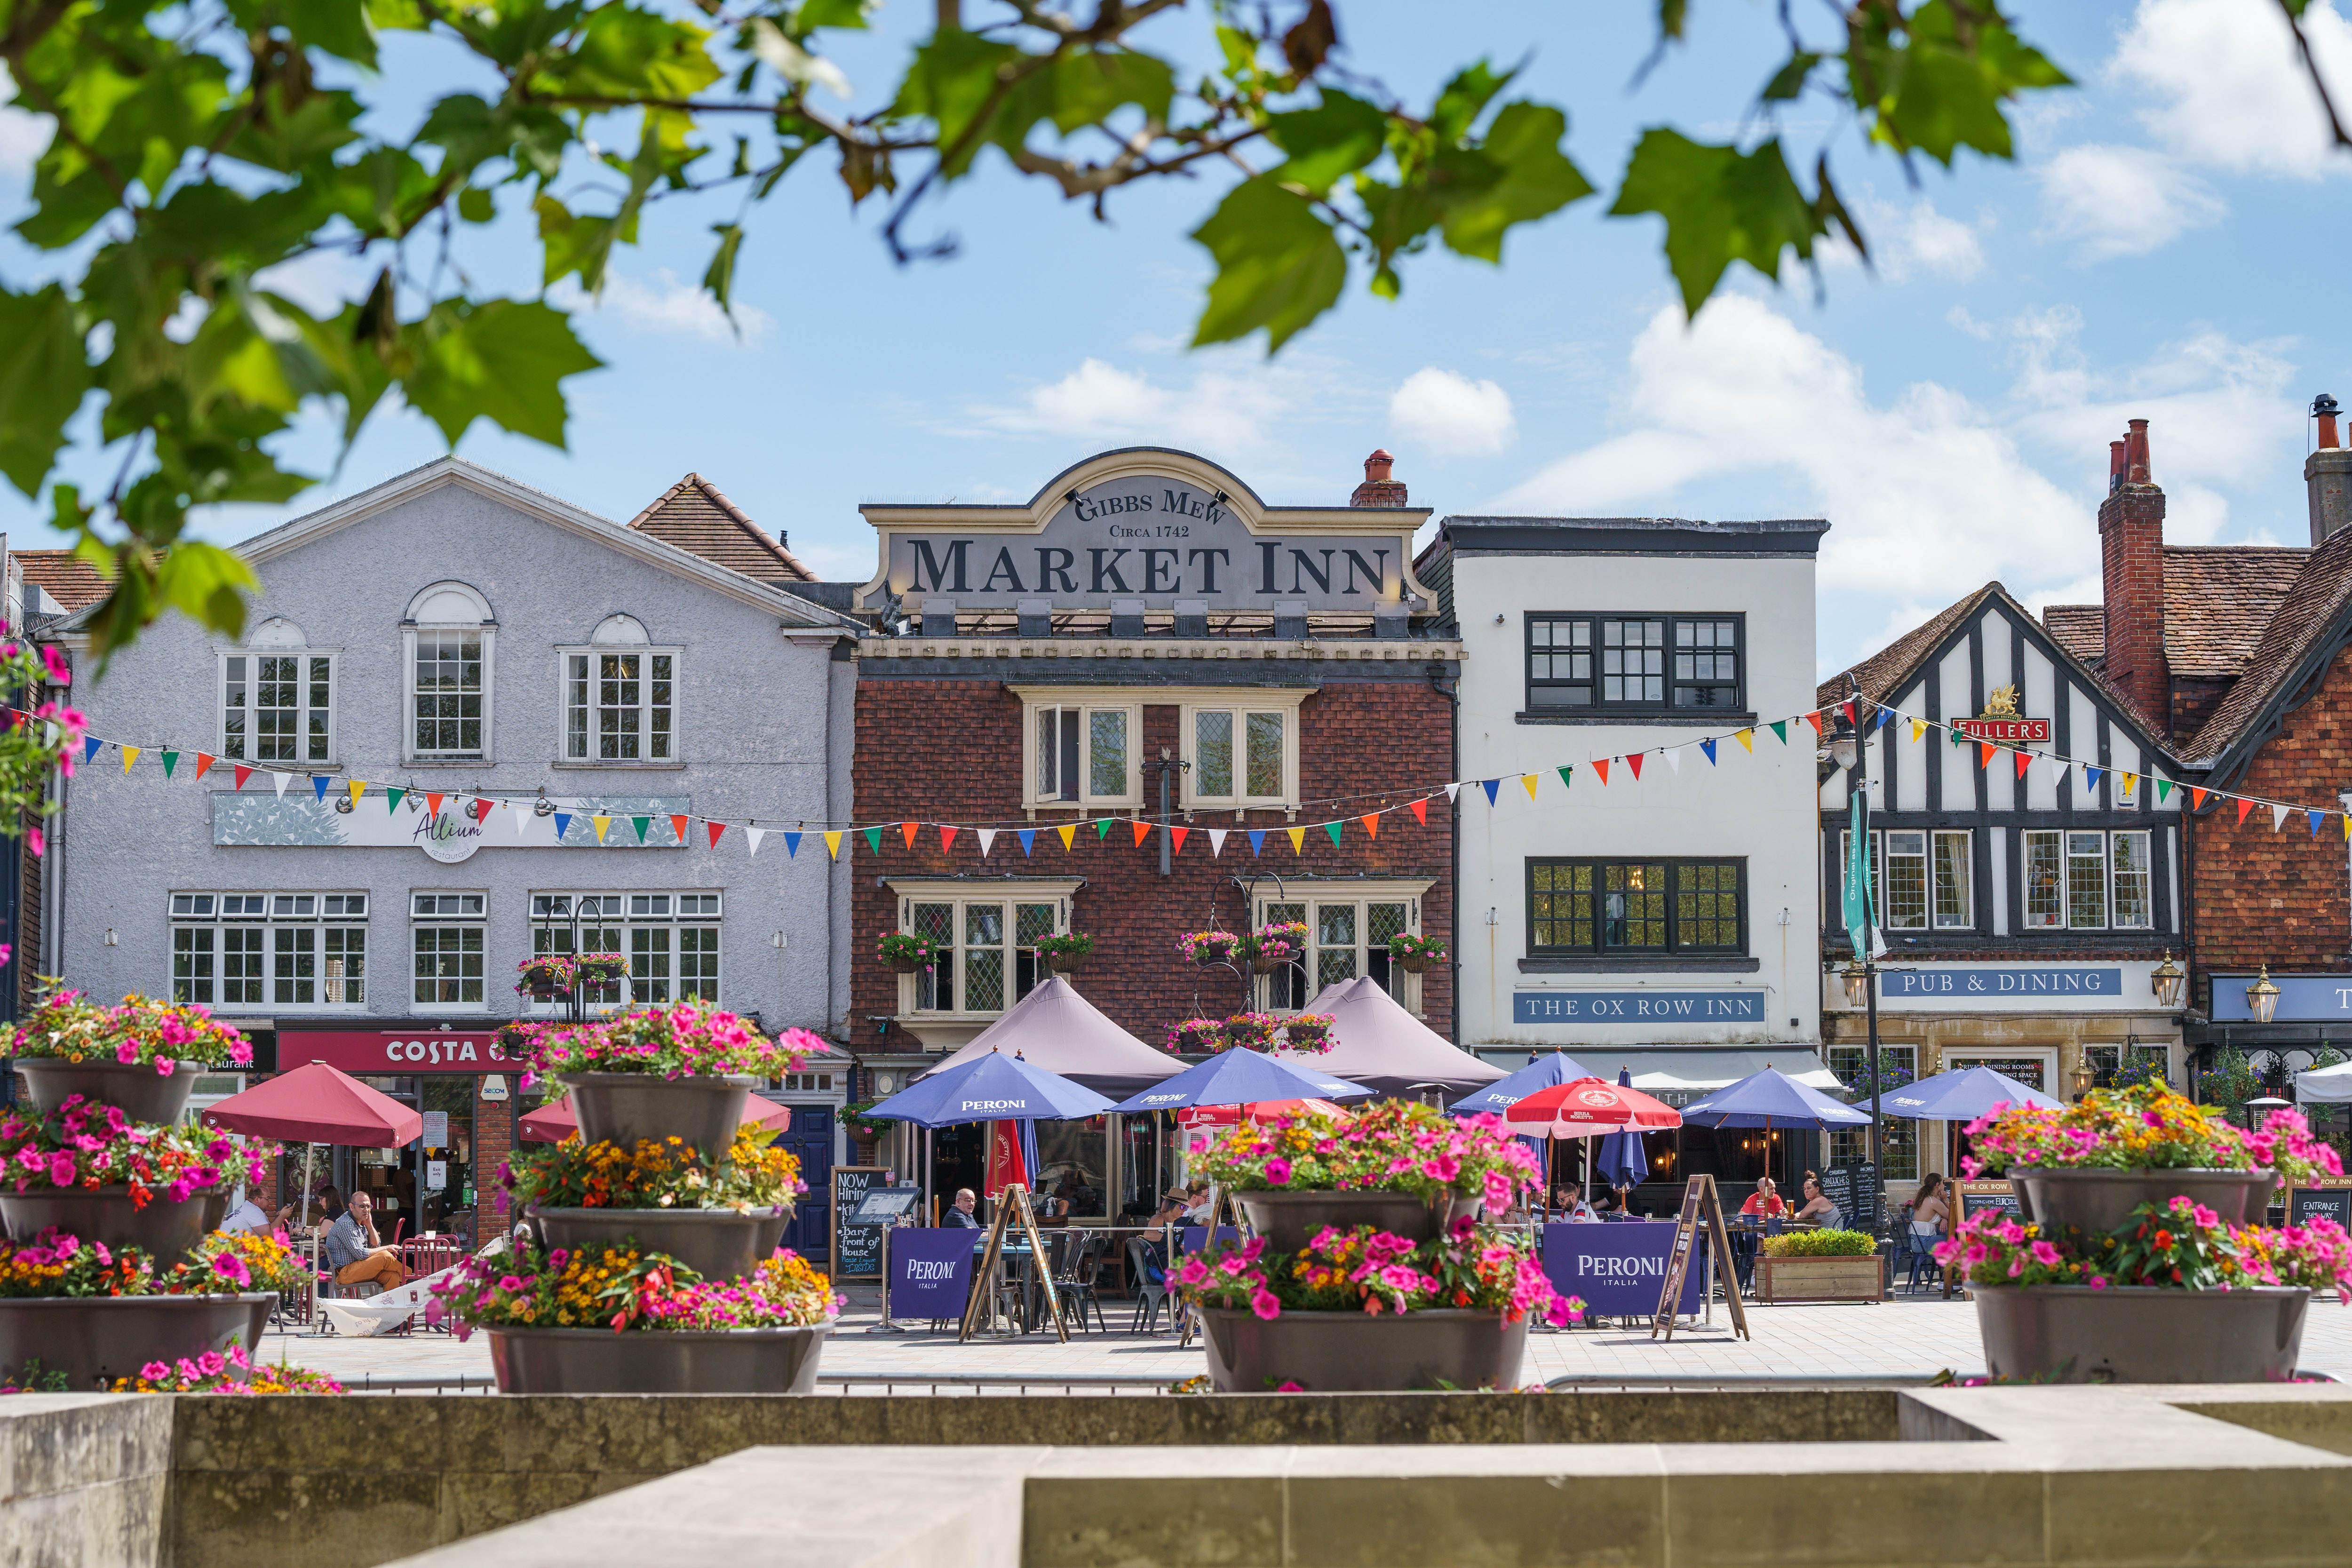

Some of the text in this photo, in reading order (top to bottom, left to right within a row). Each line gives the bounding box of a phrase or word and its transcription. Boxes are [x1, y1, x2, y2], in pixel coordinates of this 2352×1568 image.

[1110, 525, 1189, 537] CIRCA 1742
[906, 539, 1390, 595] MARKET INN
[1958, 722, 2043, 739] FULLER'S
[413, 812, 483, 843] Allium
[431, 848, 471, 859] restaurant
[1904, 973, 2102, 992] PUB & DINING
[1526, 1000, 1753, 1015] THE OX ROW INN
[387, 1041, 477, 1064] COSTA
[961, 1100, 1025, 1111] PERONI
[1140, 1094, 1187, 1103] PERONI
[1891, 1097, 1926, 1106] PERONI
[998, 1135, 1009, 1156] ORETTI
[838, 1173, 869, 1187] NOW
[1822, 1175, 1850, 1186] SANDWICHES
[2303, 1202, 2339, 1211] ENTRANCE
[839, 1236, 881, 1250] front of
[841, 1247, 869, 1257] House
[907, 1259, 956, 1279] PERONI
[1578, 1255, 1664, 1276] PERONI
